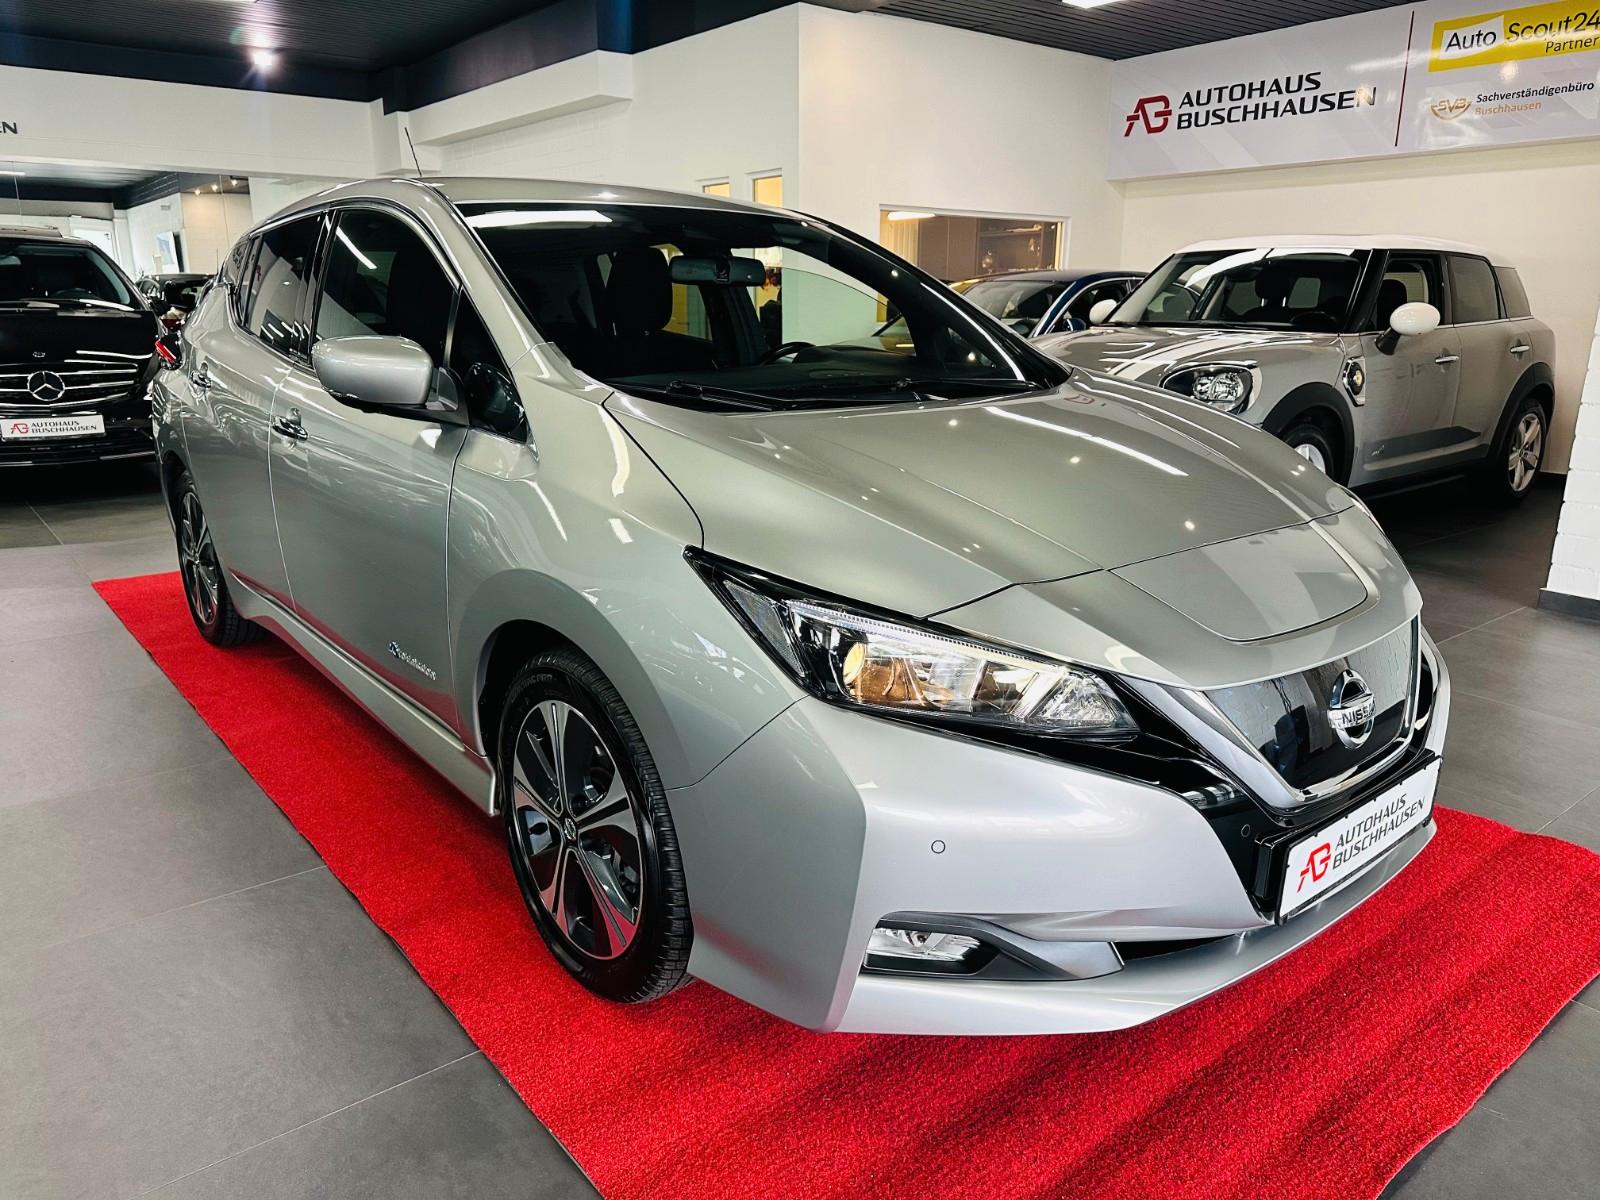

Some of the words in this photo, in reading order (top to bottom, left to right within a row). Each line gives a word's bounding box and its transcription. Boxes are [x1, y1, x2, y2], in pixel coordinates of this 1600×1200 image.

[1545, 35, 1599, 54] Partner
[1178, 71, 1322, 109] AUTOHAUS
[1476, 81, 1595, 103] Sachverständigenbüro
[1176, 86, 1377, 130] BUSCHHAUSEN
[1474, 101, 1542, 116] Buschhausen
[31, 420, 80, 428] AUTOHAUS
[31, 425, 97, 434] BUSCHHAUSEN
[1332, 795, 1426, 870] BUSCHHAUSEN
[1335, 793, 1407, 851] AUTOHAUS
